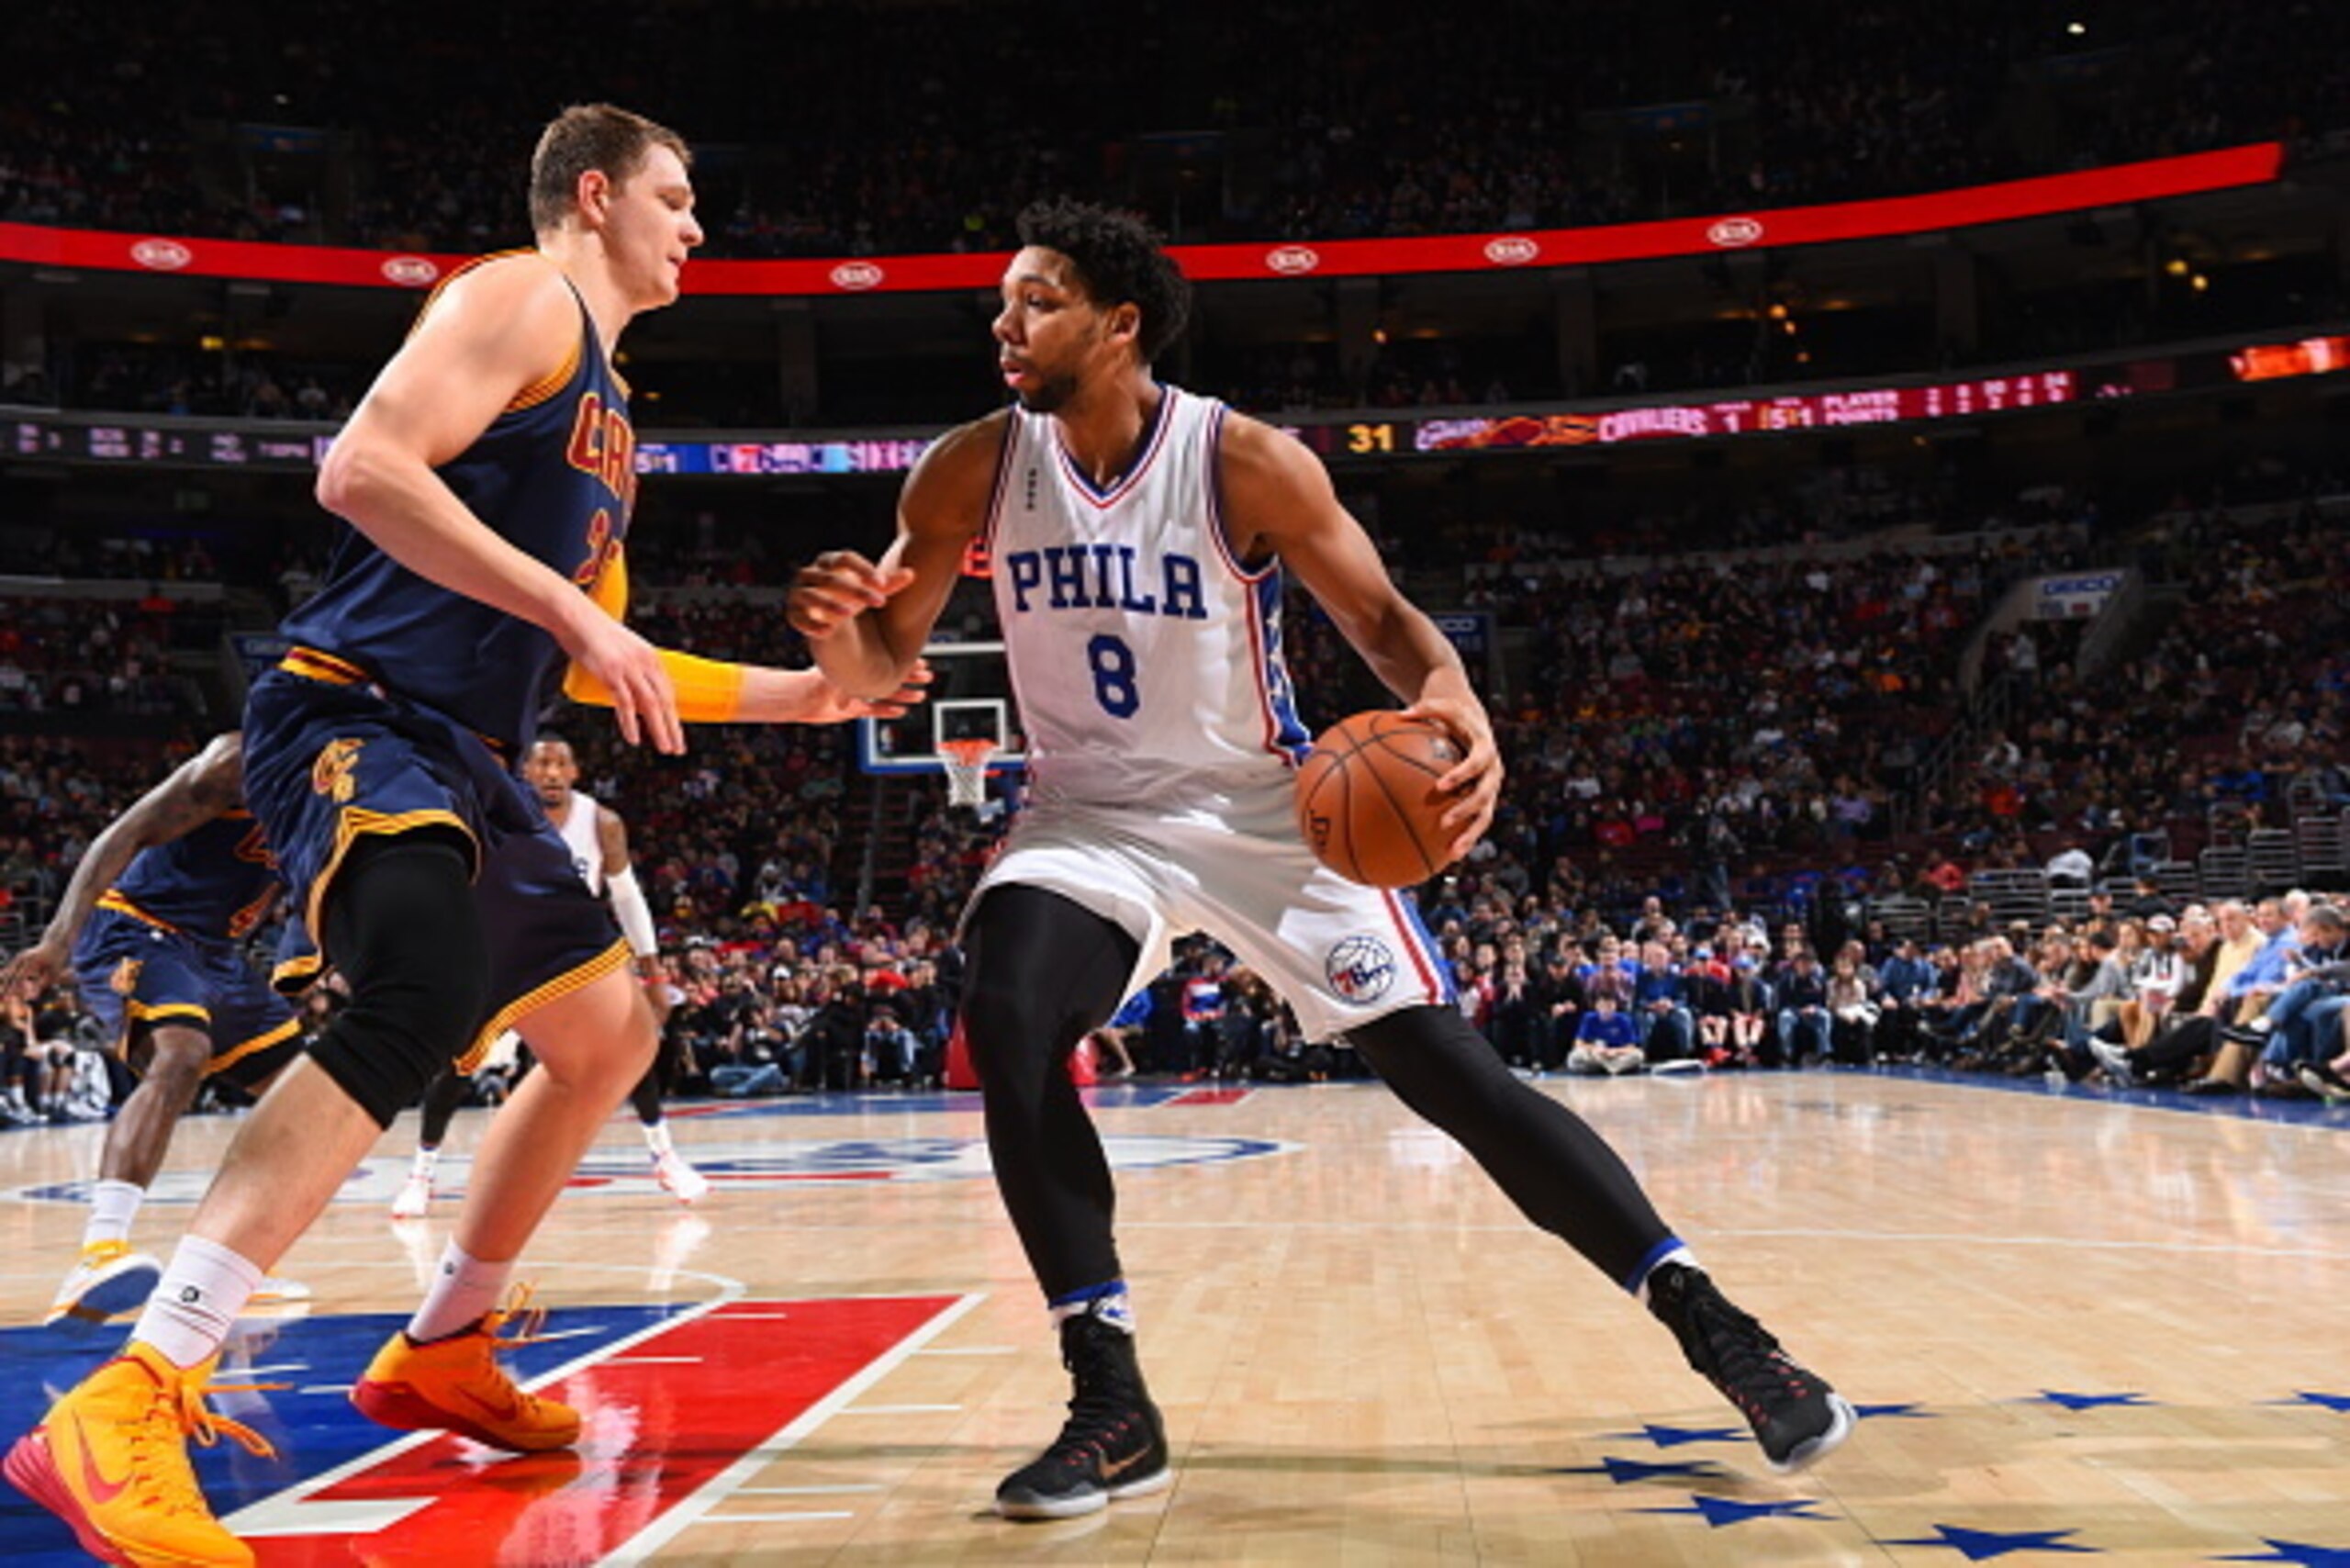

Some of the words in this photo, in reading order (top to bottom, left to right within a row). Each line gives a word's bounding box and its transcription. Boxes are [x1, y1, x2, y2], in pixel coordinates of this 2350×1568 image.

[1348, 423, 1393, 453] 31
[1007, 544, 1207, 619] PHILA
[1088, 634, 1139, 718] 8
